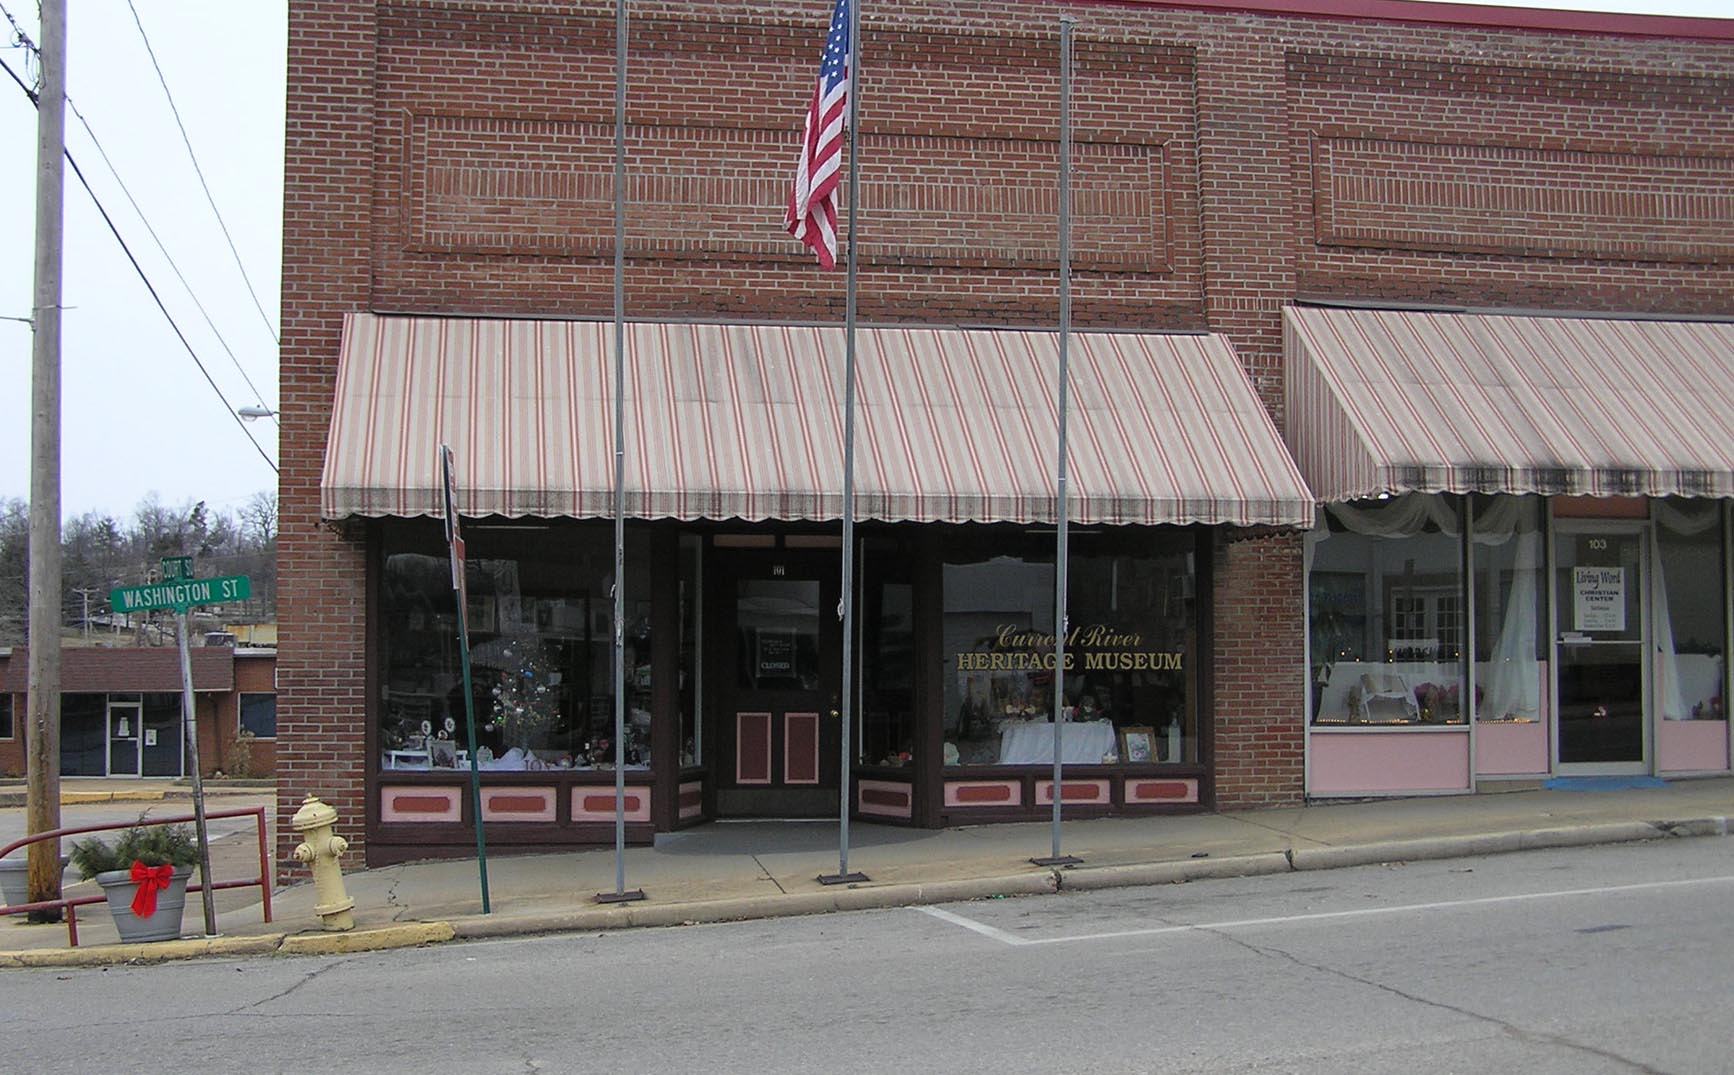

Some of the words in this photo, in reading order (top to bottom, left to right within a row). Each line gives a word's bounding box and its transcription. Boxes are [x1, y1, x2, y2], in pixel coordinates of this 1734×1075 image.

[1588, 539, 1607, 550] 103
[1576, 570, 1599, 590] Living
[1600, 570, 1621, 584] Word
[123, 583, 210, 608] WASHINGTON
[222, 579, 238, 598] ST
[1080, 623, 1144, 648] River
[957, 652, 1074, 670] HERITAGE
[1085, 652, 1183, 670] MUSEUM
